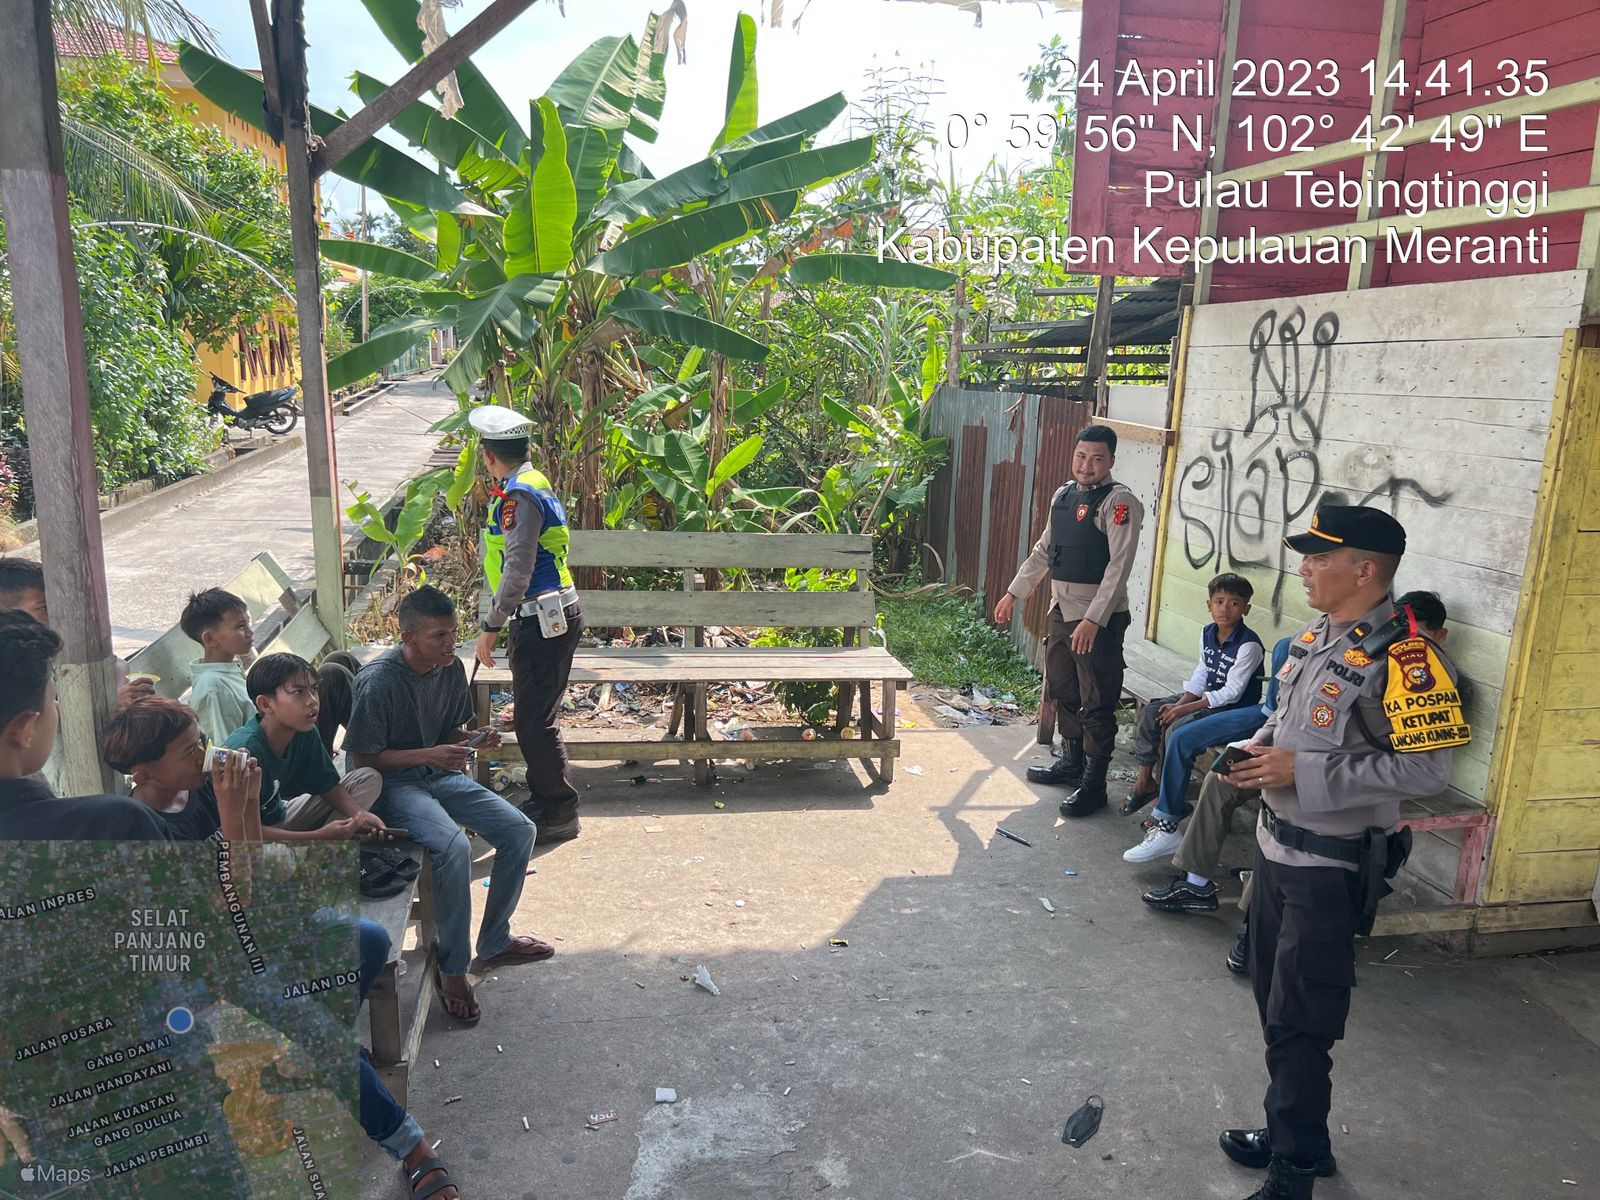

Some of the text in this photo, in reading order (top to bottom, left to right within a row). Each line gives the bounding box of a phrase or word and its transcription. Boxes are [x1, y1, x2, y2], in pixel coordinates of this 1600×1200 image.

[1401, 653, 1424, 661] RIAU
[1325, 659, 1366, 688] POLRI
[1385, 691, 1459, 714] KA POSPAM
[1401, 710, 1450, 730] KETUPAT
